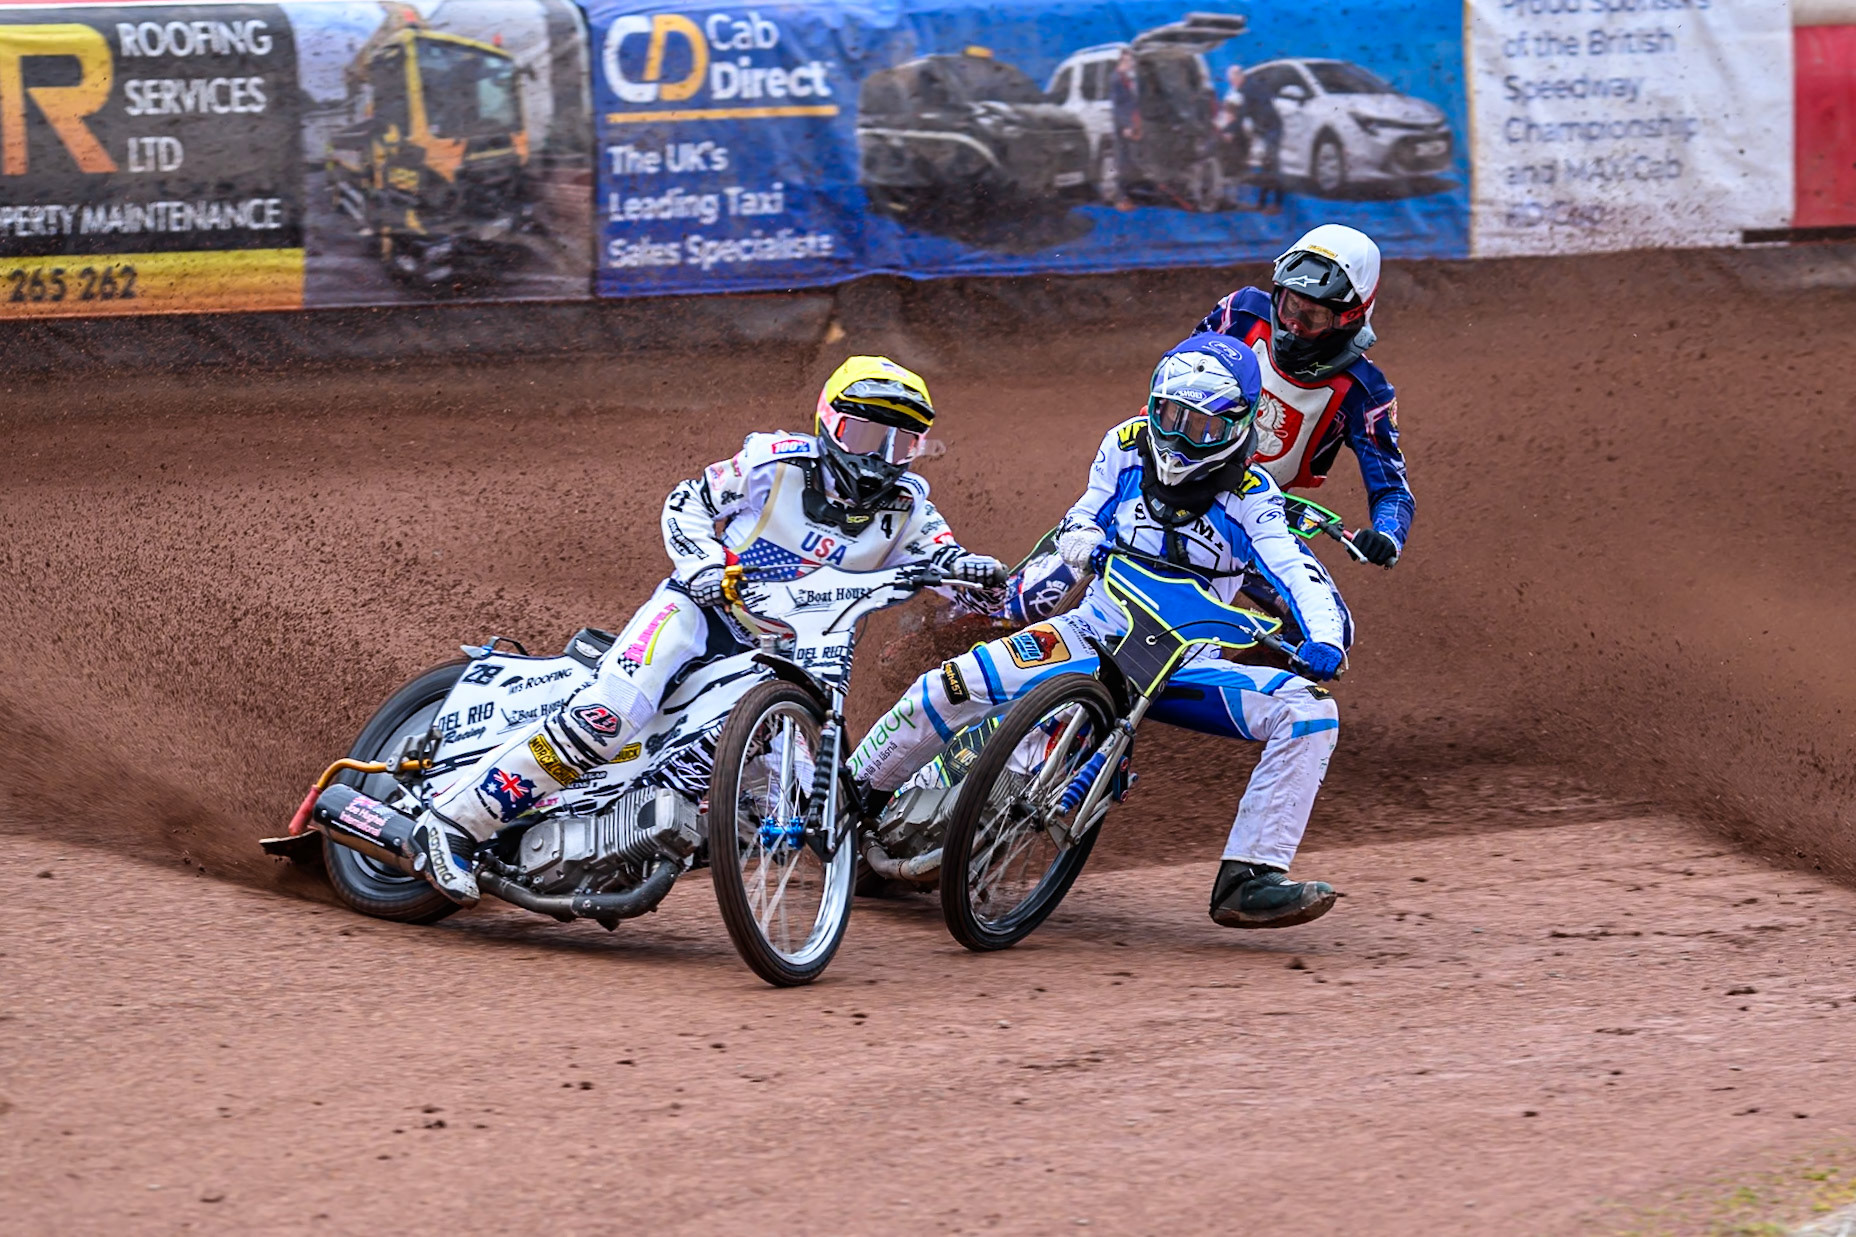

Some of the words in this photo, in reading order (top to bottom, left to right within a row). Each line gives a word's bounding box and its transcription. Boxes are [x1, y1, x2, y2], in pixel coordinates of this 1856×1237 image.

[116, 20, 272, 58] ROOFING
[707, 12, 779, 50] Cab
[1506, 31, 1528, 57] of
[1534, 30, 1578, 56] the
[1588, 28, 1675, 55] British
[711, 57, 831, 99] Direct
[1504, 74, 1645, 102] Speedway
[123, 76, 267, 116] SERVICES
[1505, 113, 1698, 144] Championship
[127, 136, 183, 174] LTD
[607, 145, 661, 174] The
[1506, 158, 1557, 186] and
[80, 198, 281, 234] MAINTENANCE
[609, 188, 718, 225] Leading
[724, 182, 784, 216] Taxi
[608, 236, 682, 267] Sales
[685, 229, 834, 271] Specialists
[9, 267, 67, 301] 265
[79, 265, 137, 300] 262
[774, 440, 809, 453] 100%
[880, 513, 893, 540] 4
[801, 531, 847, 566] USA
[807, 590, 832, 602] Boat
[797, 647, 817, 660] DEL
[525, 668, 573, 689] ROOFING
[438, 711, 461, 731] DEL
[468, 701, 494, 725] RIO
